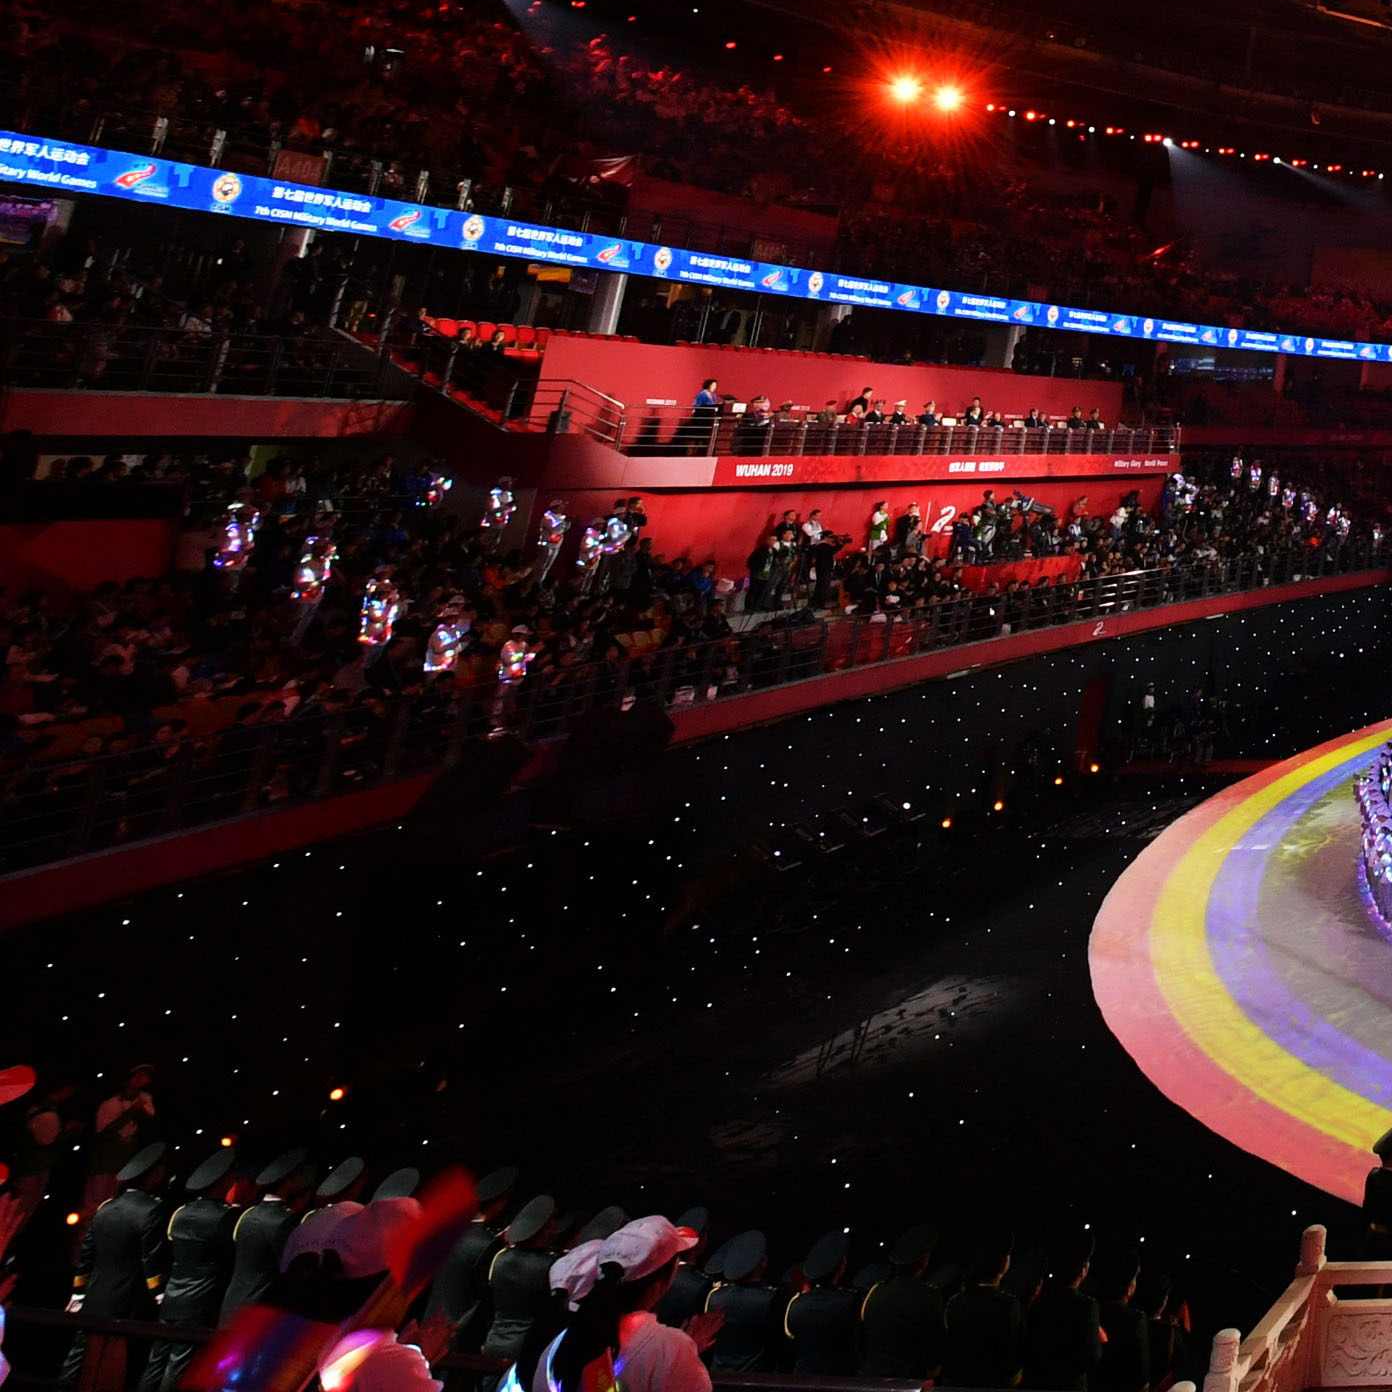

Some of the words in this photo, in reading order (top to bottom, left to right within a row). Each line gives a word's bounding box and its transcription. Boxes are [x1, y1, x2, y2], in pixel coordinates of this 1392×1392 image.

[0, 138, 90, 165] 世界军人运动会
[27, 169, 60, 183] World
[61, 173, 97, 188] Games
[255, 206, 270, 216] 7th
[271, 208, 293, 219] CISM
[294, 211, 325, 226] Military
[326, 217, 350, 228] World
[351, 220, 377, 232] Games
[736, 464, 771, 477] WUHAN
[771, 463, 793, 476] 2019
